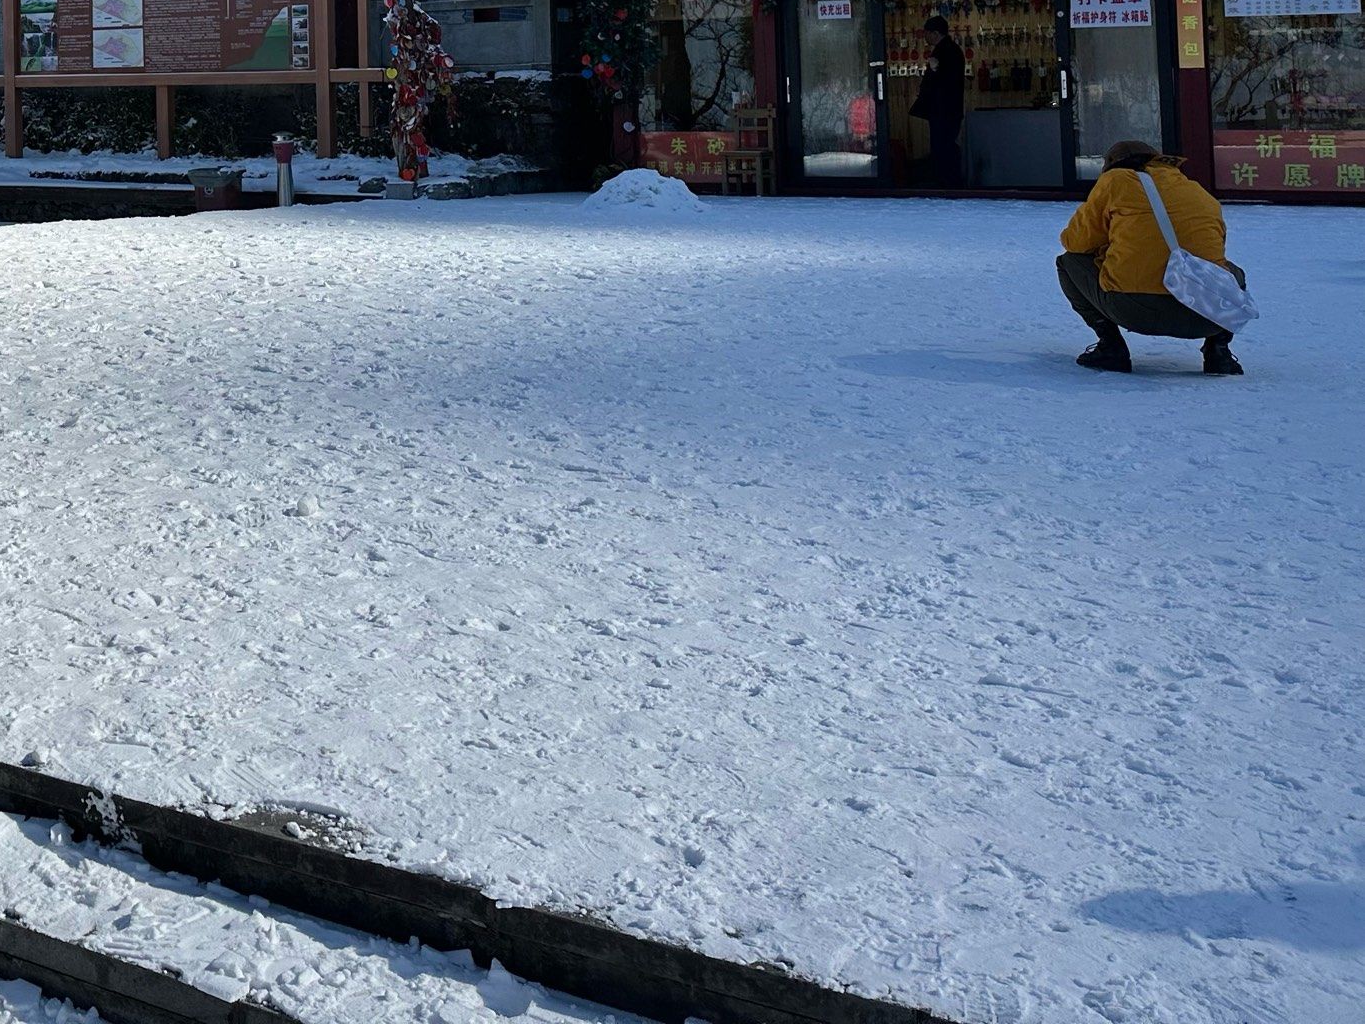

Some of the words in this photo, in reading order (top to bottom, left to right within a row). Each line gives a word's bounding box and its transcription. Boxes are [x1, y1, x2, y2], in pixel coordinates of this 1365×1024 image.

[820, 4, 850, 16] 快充出租
[1121, 10, 1149, 23] 冰箱贴
[670, 137, 726, 156] 朱砂
[1255, 134, 1337, 158] 祈福
[1230, 163, 1365, 188] 许愿牌
